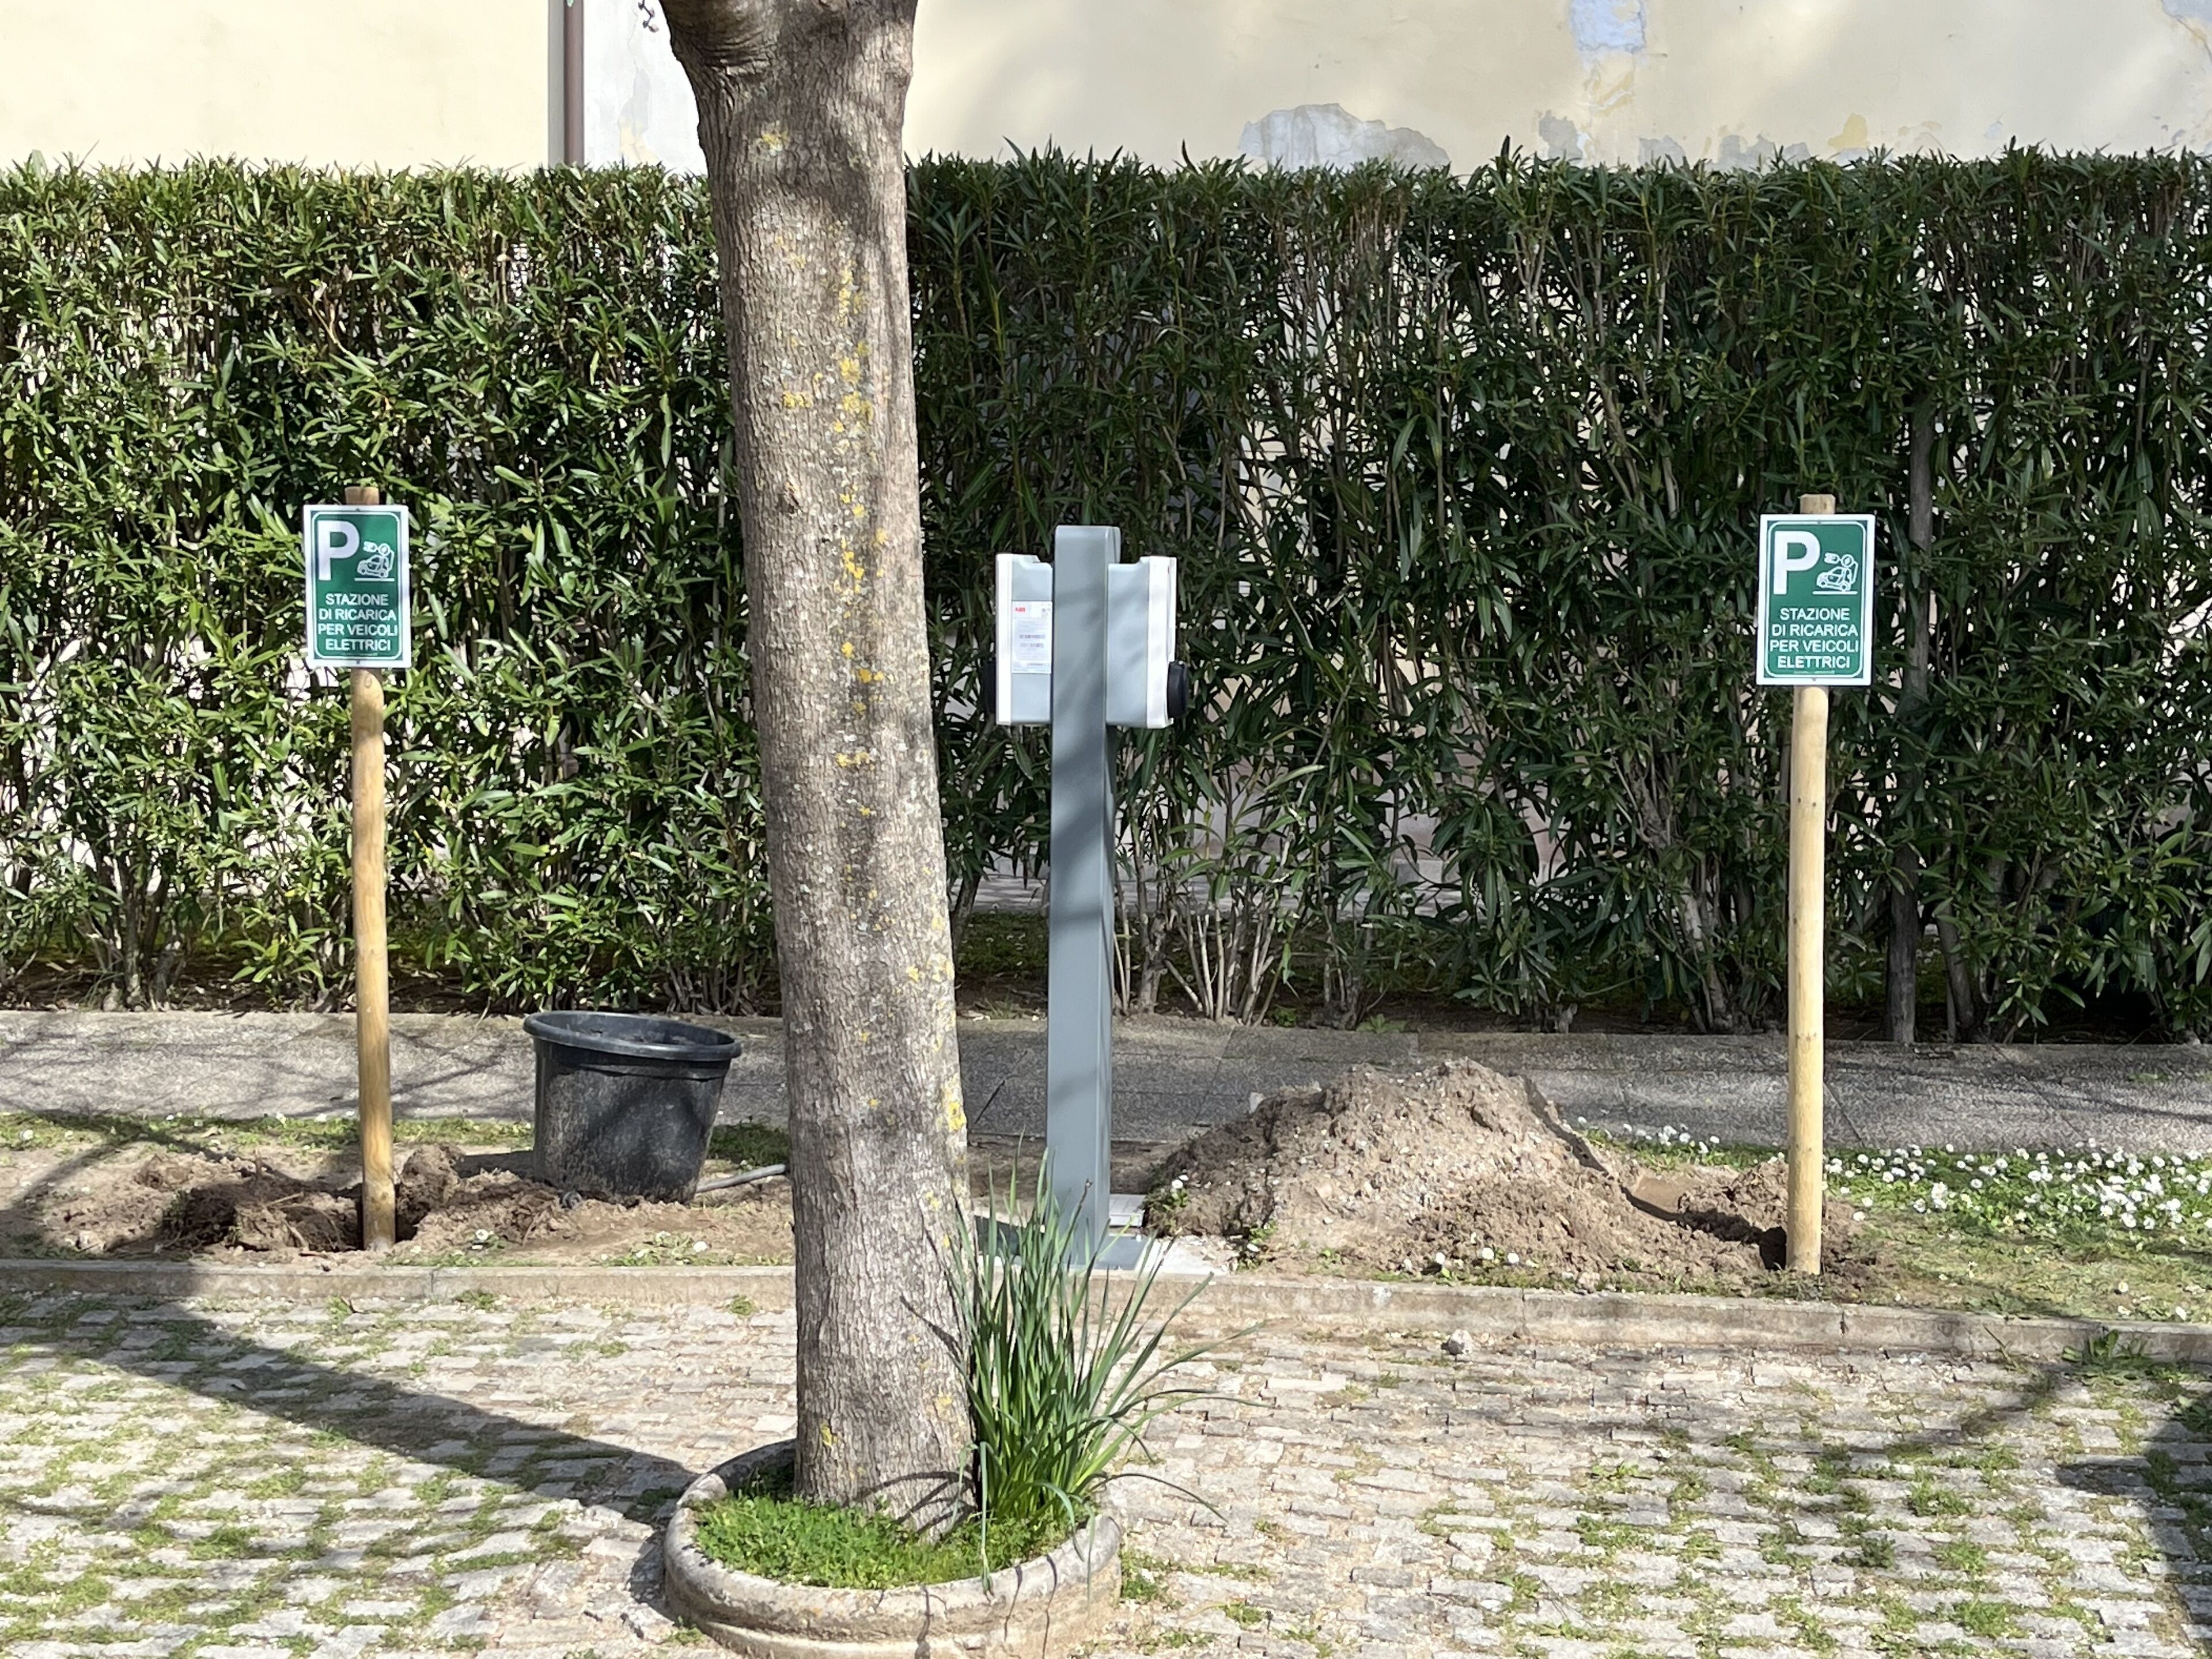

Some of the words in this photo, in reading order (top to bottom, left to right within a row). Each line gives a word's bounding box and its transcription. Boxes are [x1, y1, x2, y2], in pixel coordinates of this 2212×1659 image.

[317, 520, 360, 581] P
[1773, 531, 1821, 594] P
[325, 593, 389, 605] STAZIONE
[319, 608, 332, 620] DI
[335, 608, 397, 621] RICARICA
[1780, 608, 1850, 620] STAZIONE
[318, 623, 344, 635] PER
[347, 624, 398, 637] VEICOLI
[1772, 624, 1786, 637] DI
[1790, 624, 1858, 637] RICARICA
[325, 638, 391, 652] ELETTRICI
[1770, 639, 1799, 653] PER
[1803, 640, 1858, 653] VEICOLI
[1778, 656, 1850, 668] ELETTRICI
